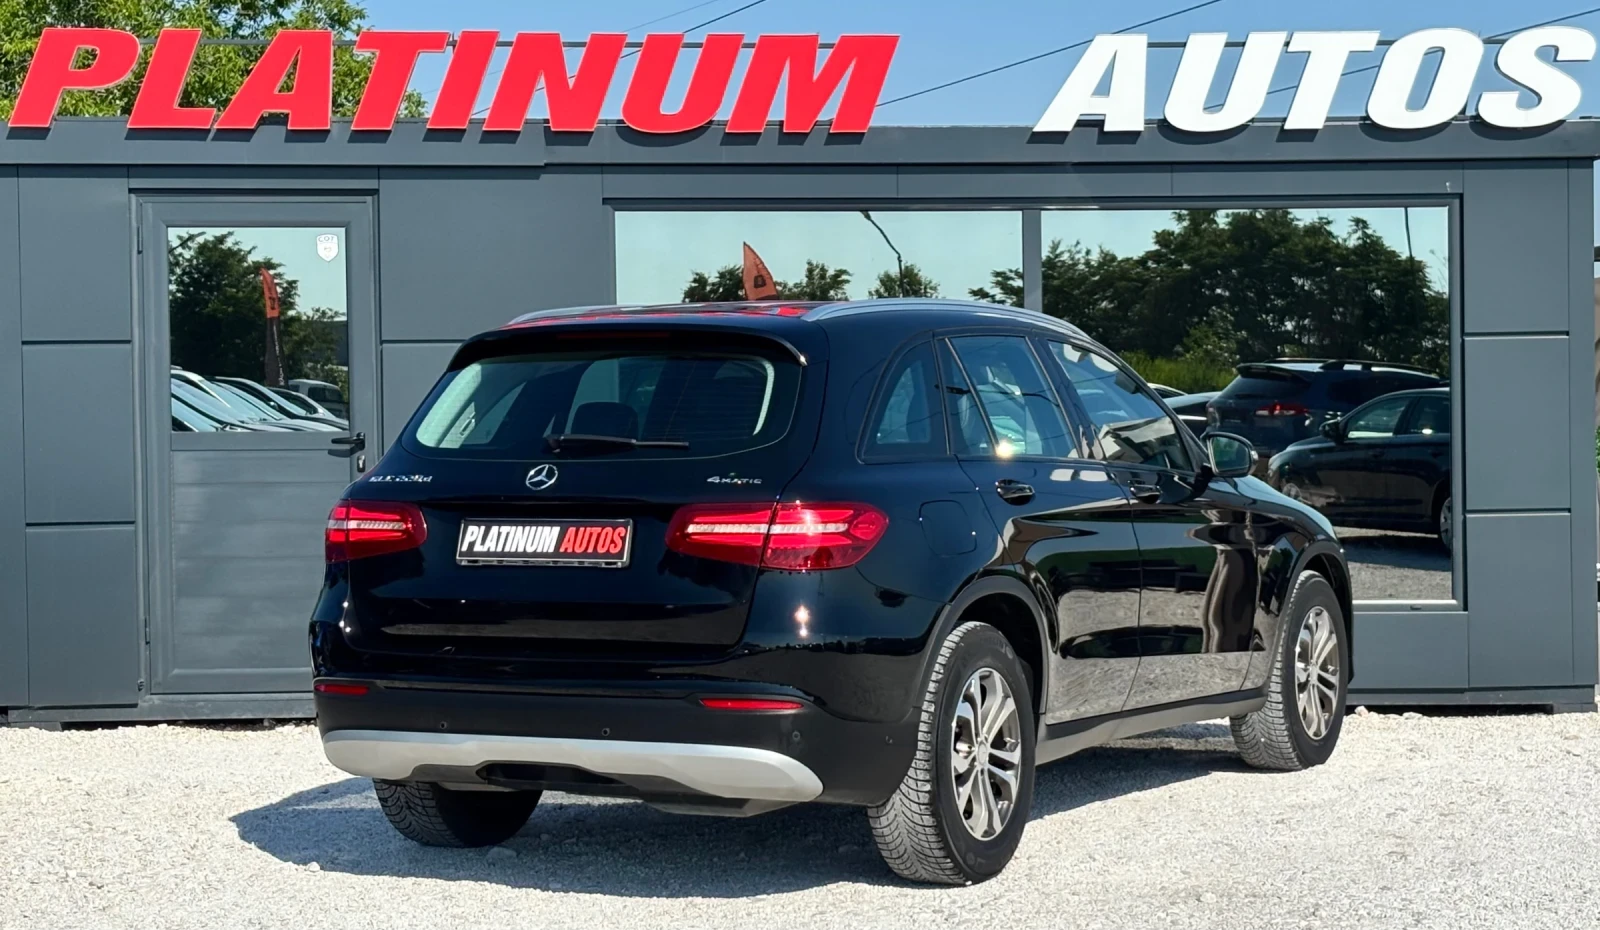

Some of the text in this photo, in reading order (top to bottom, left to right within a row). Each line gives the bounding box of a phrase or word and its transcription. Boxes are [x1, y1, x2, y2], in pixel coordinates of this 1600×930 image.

[7, 26, 1598, 135] PLATINUM AUTOS
[461, 525, 627, 554] PLATINUM AUTOS
